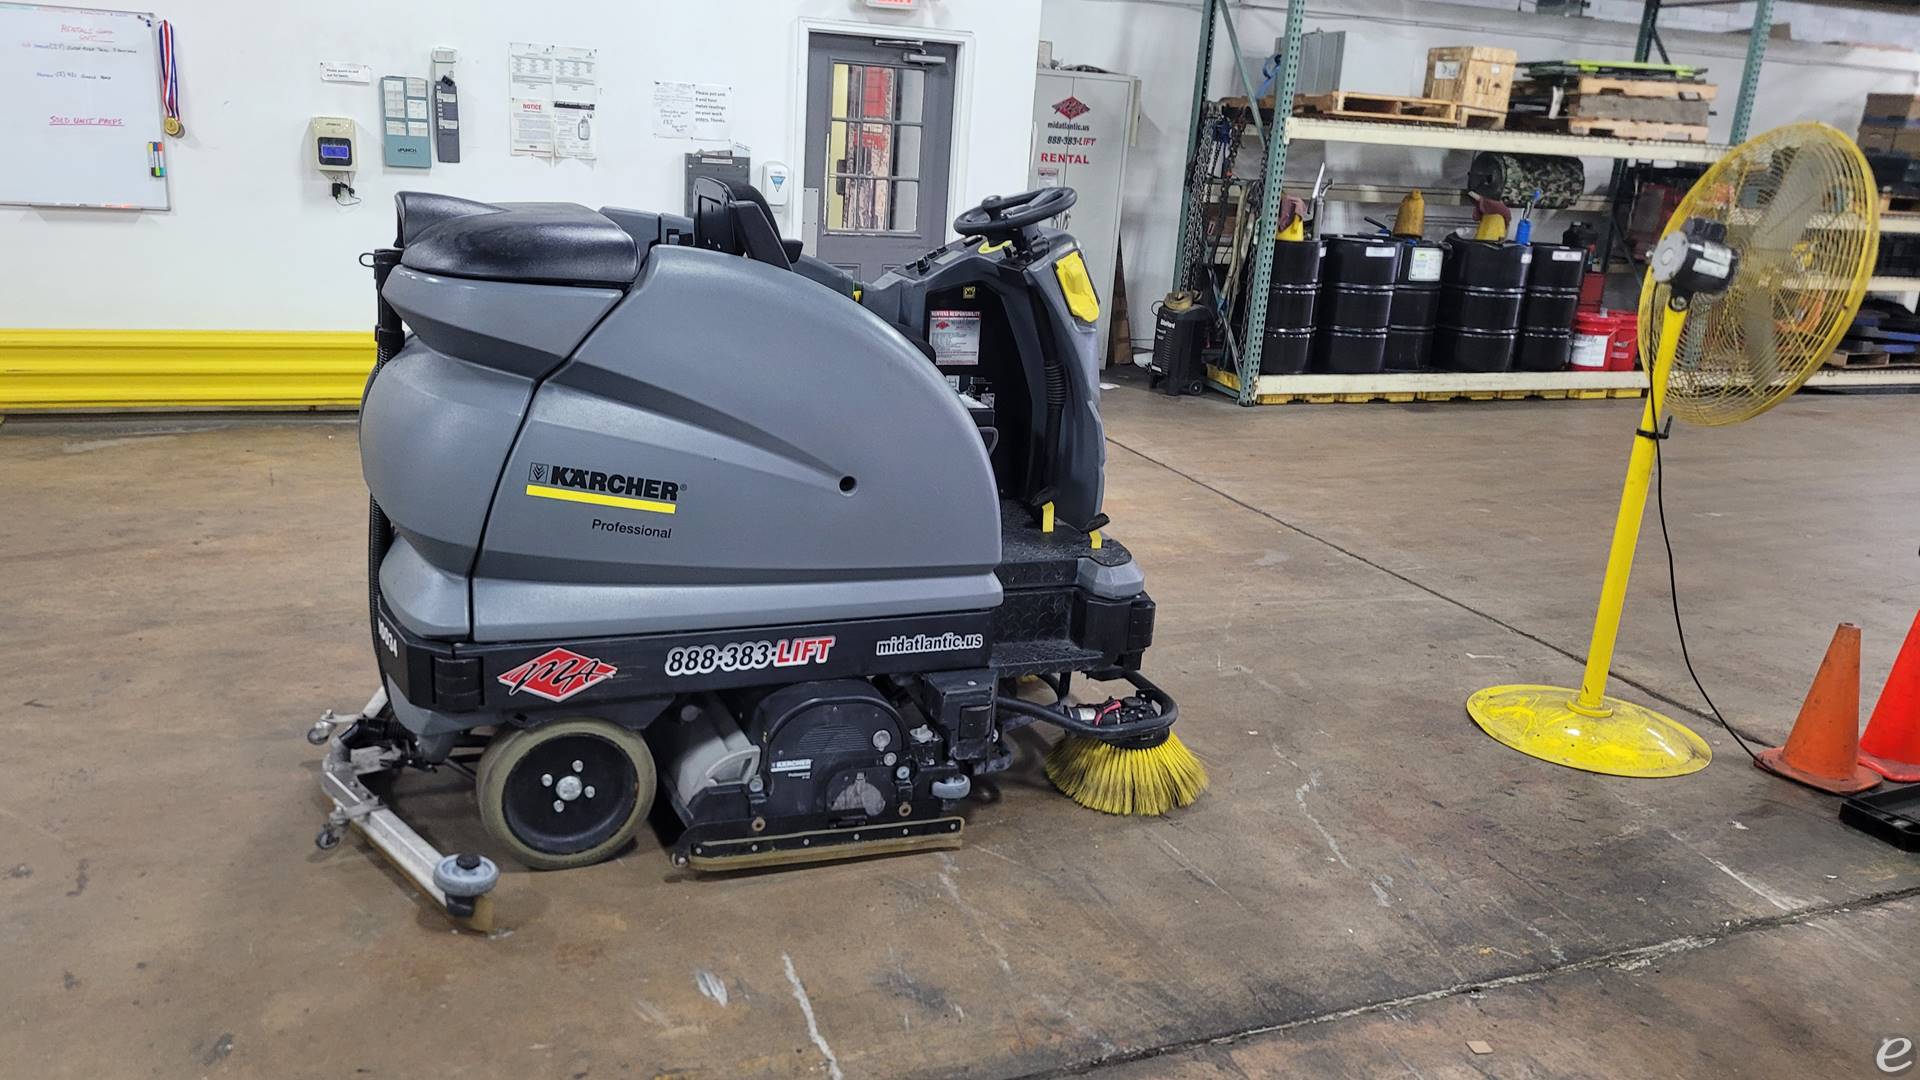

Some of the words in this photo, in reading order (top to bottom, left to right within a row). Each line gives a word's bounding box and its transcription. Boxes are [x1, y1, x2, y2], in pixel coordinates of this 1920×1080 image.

[1047, 121, 1090, 131] midatlantic.us
[1047, 135, 1097, 146] 888-383-LIFT
[1040, 152, 1090, 164] RENTAL
[550, 465, 679, 501] KÄRCHER
[592, 519, 672, 539] Professional
[877, 633, 983, 655] midatlantic.us
[667, 637, 834, 674] 888-383-LIFT
